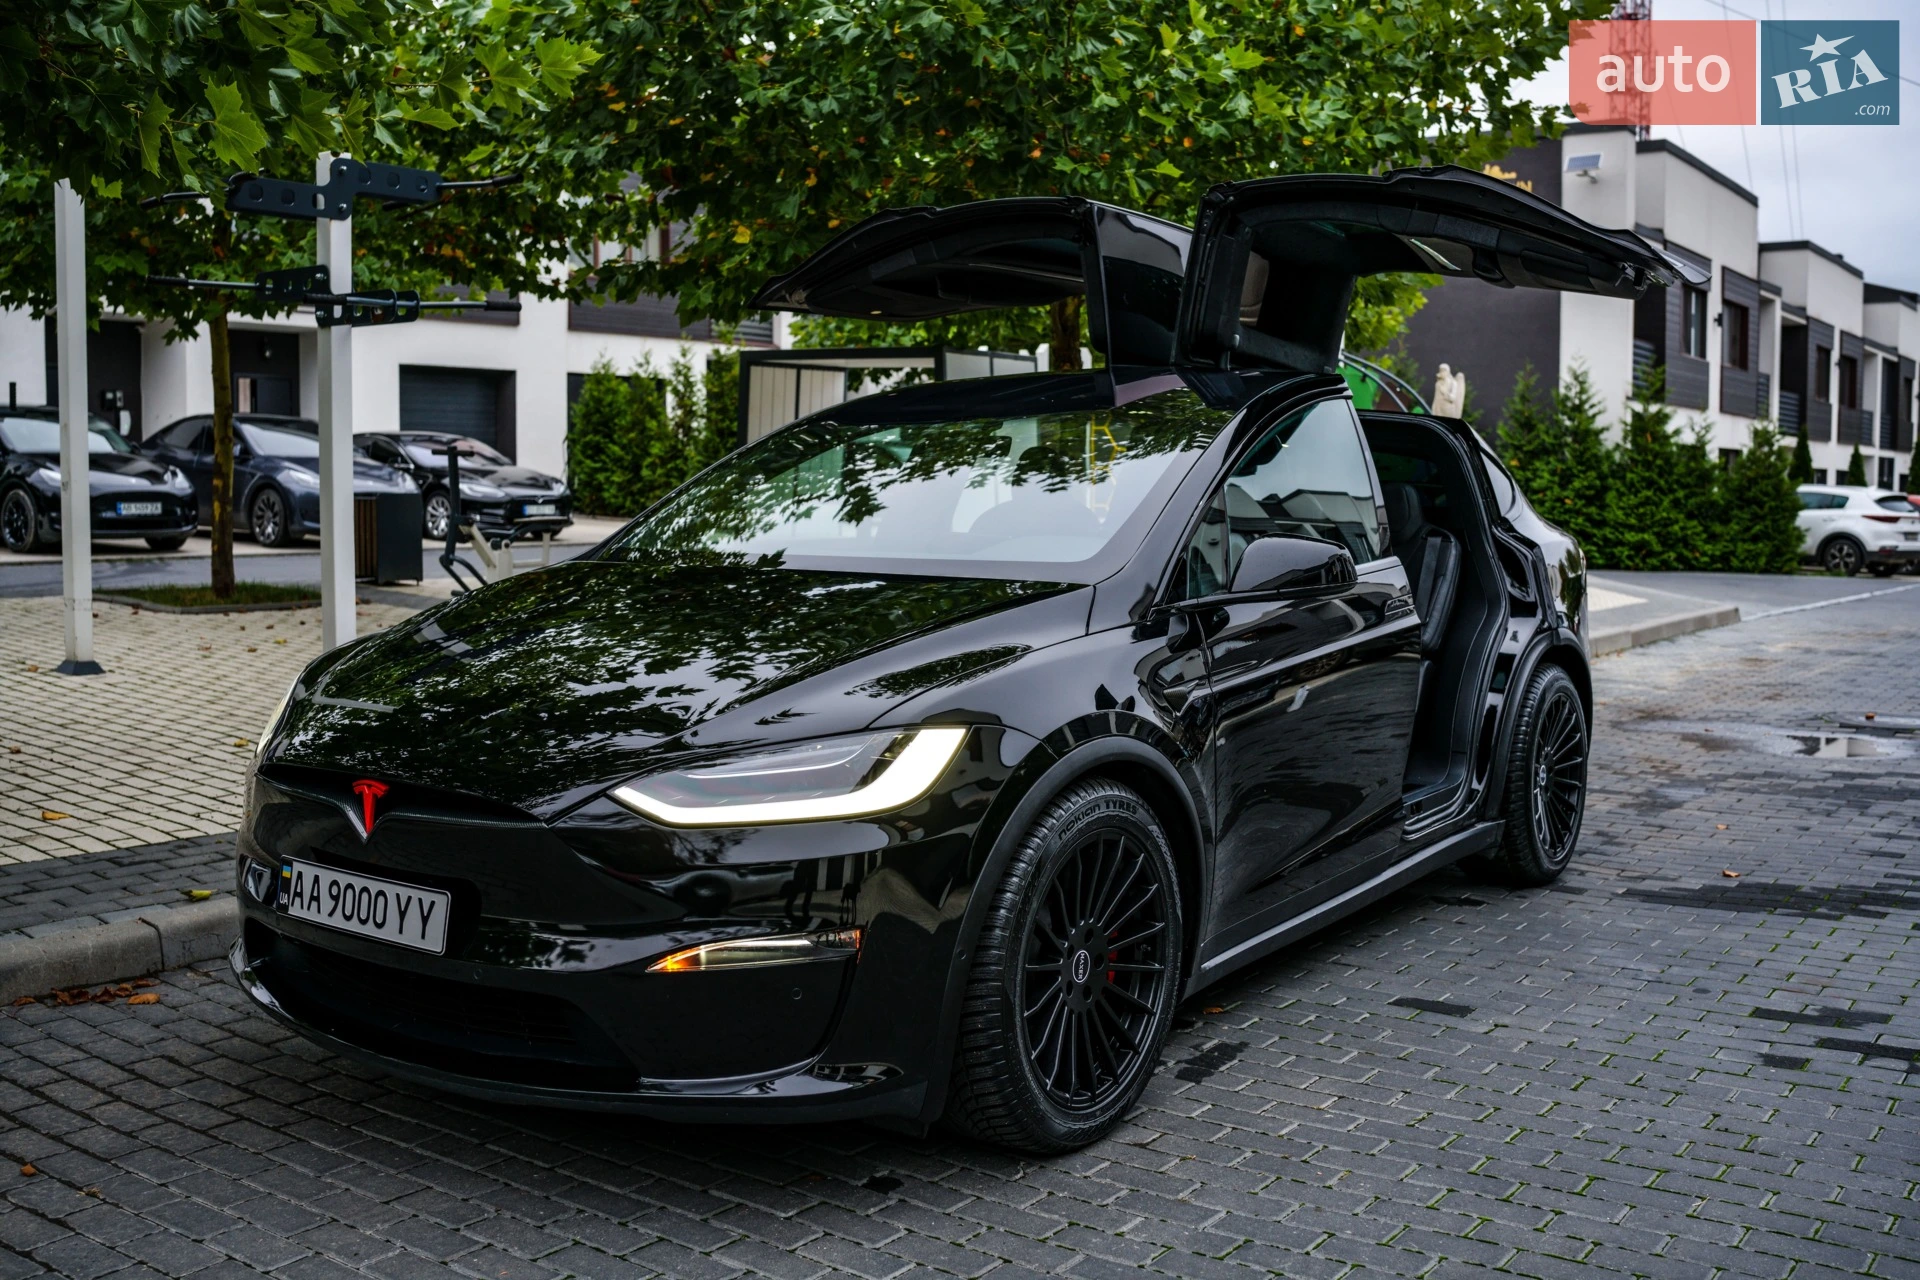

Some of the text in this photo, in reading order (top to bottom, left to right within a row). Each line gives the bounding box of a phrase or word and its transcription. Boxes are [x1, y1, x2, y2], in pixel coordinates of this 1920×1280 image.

[1103, 799, 1138, 816] TYRES
[279, 891, 289, 906] UA
[290, 870, 436, 940] AA 9000 YY
